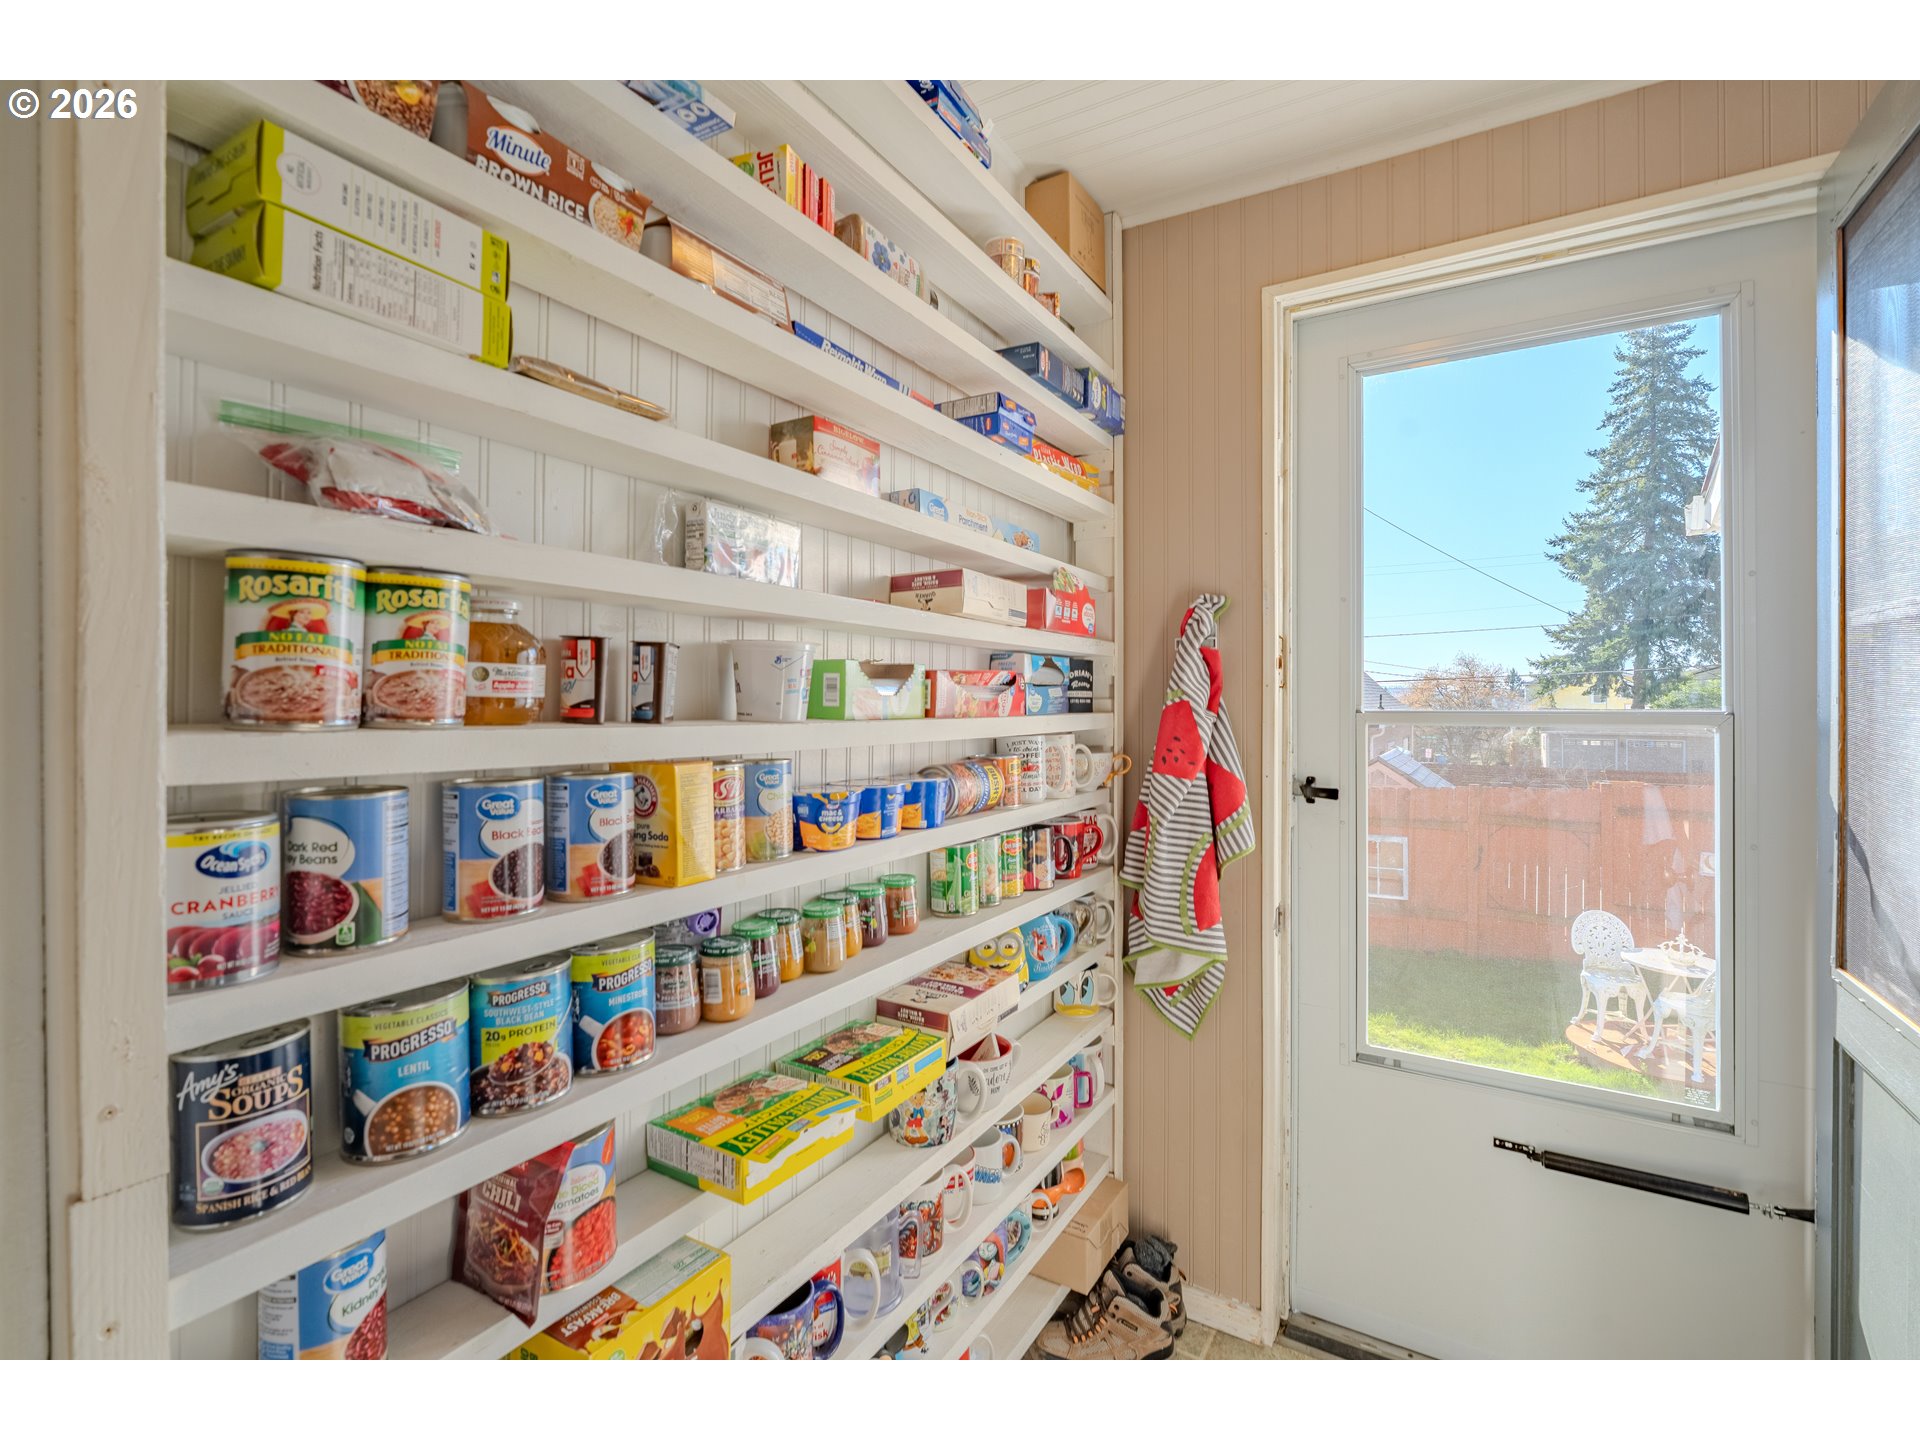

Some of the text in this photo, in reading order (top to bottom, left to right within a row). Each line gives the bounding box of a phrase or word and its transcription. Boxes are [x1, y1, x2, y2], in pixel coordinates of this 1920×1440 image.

[488, 128, 551, 170] Minute
[476, 154, 545, 202] BROWN
[548, 189, 585, 221] RICE
[833, 425, 865, 445] BIGELOW
[958, 513, 989, 533] Parchment
[238, 573, 356, 612] Rosarita
[268, 632, 325, 645] NO FAT
[404, 640, 422, 651] NO
[481, 798, 515, 812] Great
[590, 788, 618, 801] Great
[489, 806, 515, 817] Value
[599, 816, 622, 828] Black
[821, 809, 837, 817] mac
[490, 828, 524, 841] Black
[636, 823, 650, 834] pure
[648, 830, 669, 842] Soda
[287, 841, 339, 853] Dark Red
[200, 853, 239, 873] Ocean
[298, 852, 339, 865] Beans
[170, 884, 280, 916] CRANBERRY
[598, 958, 653, 991] PROGRESSO
[491, 981, 548, 1007] PROGRESSO
[607, 987, 648, 1008] MINESTRONE
[373, 1008, 450, 1031] VEGETABLE CLASSICS
[495, 1010, 545, 1027] BLACK BEAN
[508, 1020, 556, 1039] PROTEIN
[370, 1020, 453, 1062] PROGRESSO
[397, 1060, 431, 1078] LENTIL
[850, 1053, 902, 1082] VALLEY
[176, 1063, 243, 1111] Amy's
[208, 1064, 304, 1121] SOUPS
[230, 1073, 288, 1097] ORGANIC
[742, 1094, 804, 1129] CRUNCHY
[787, 1088, 846, 1120] NATURE
[726, 1108, 793, 1153] VALLEY
[194, 1195, 242, 1215] SPANISH
[243, 1188, 269, 1208] RICE
[269, 1185, 279, 1197] &
[279, 1174, 298, 1192] RED
[570, 1176, 600, 1196] Diced
[481, 1180, 522, 1214] CHILI
[331, 1255, 369, 1281] Great
[340, 1268, 370, 1287] Value
[341, 1285, 380, 1317] Kidney
[560, 1290, 622, 1338] BREAKFAST
